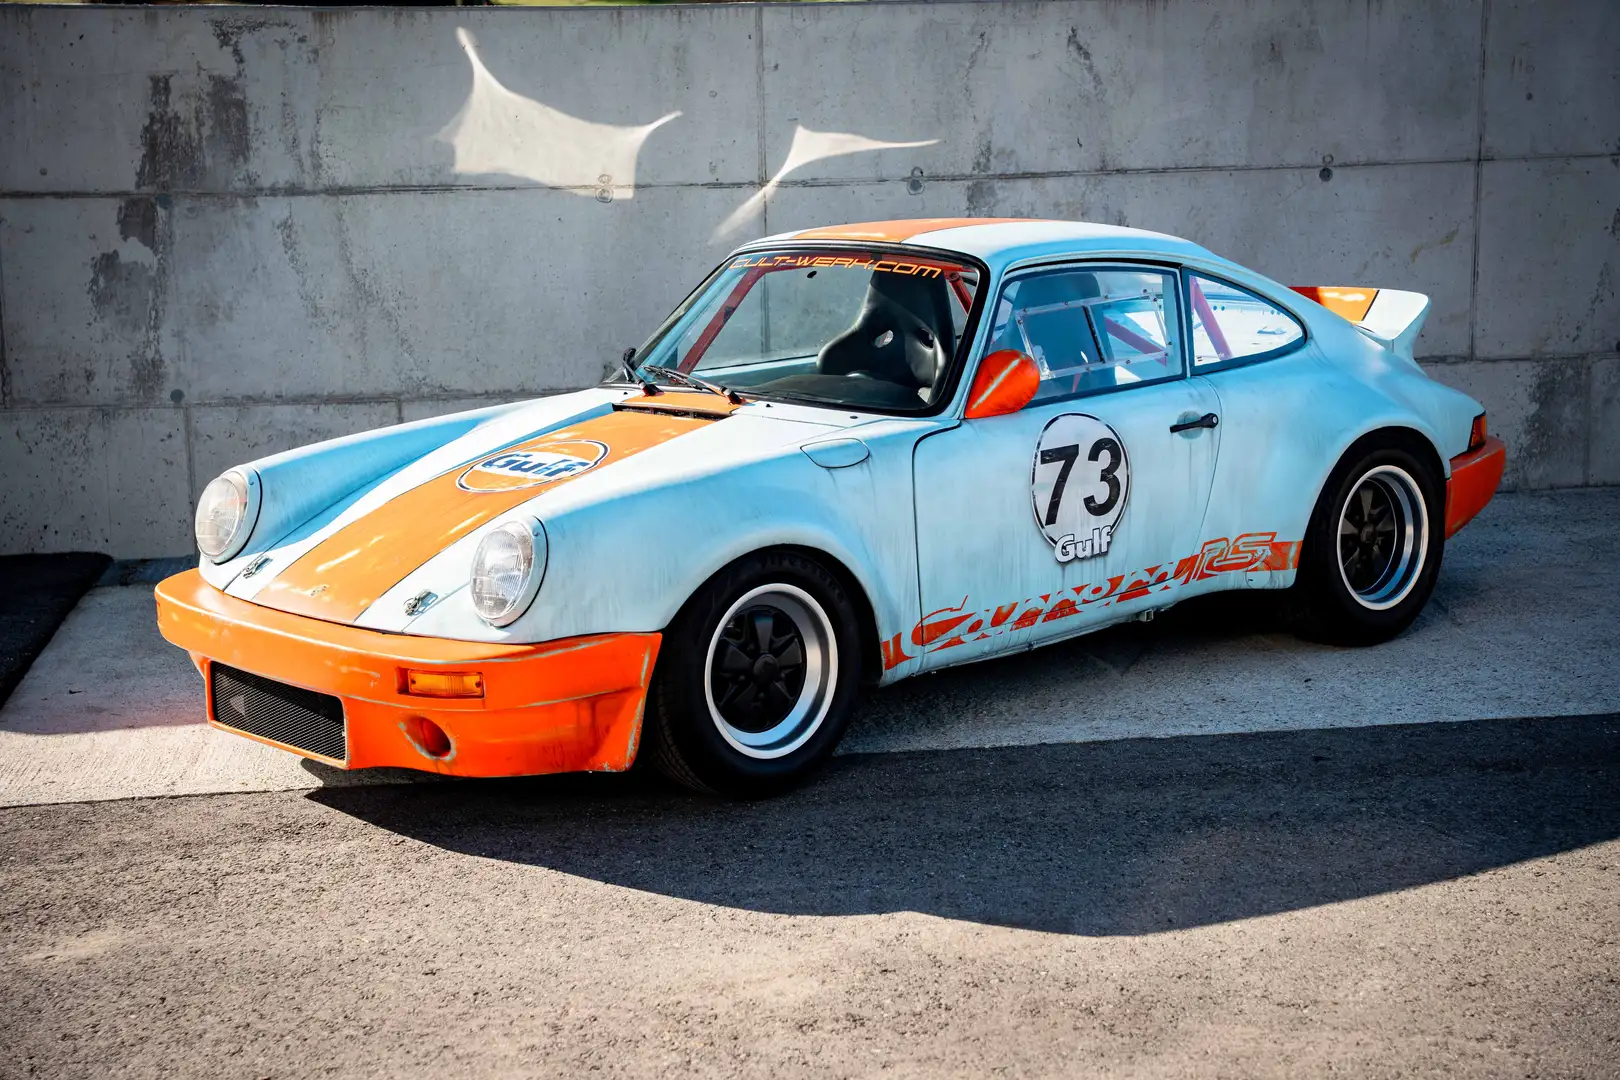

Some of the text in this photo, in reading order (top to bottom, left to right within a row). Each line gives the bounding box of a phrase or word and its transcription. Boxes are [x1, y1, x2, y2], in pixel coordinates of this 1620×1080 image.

[729, 256, 942, 279] CULT-WERK.COM
[482, 453, 591, 477] Gulf
[1040, 437, 1122, 526] 73
[1055, 525, 1113, 563] Gulf
[904, 531, 1278, 657] Carrera RS
